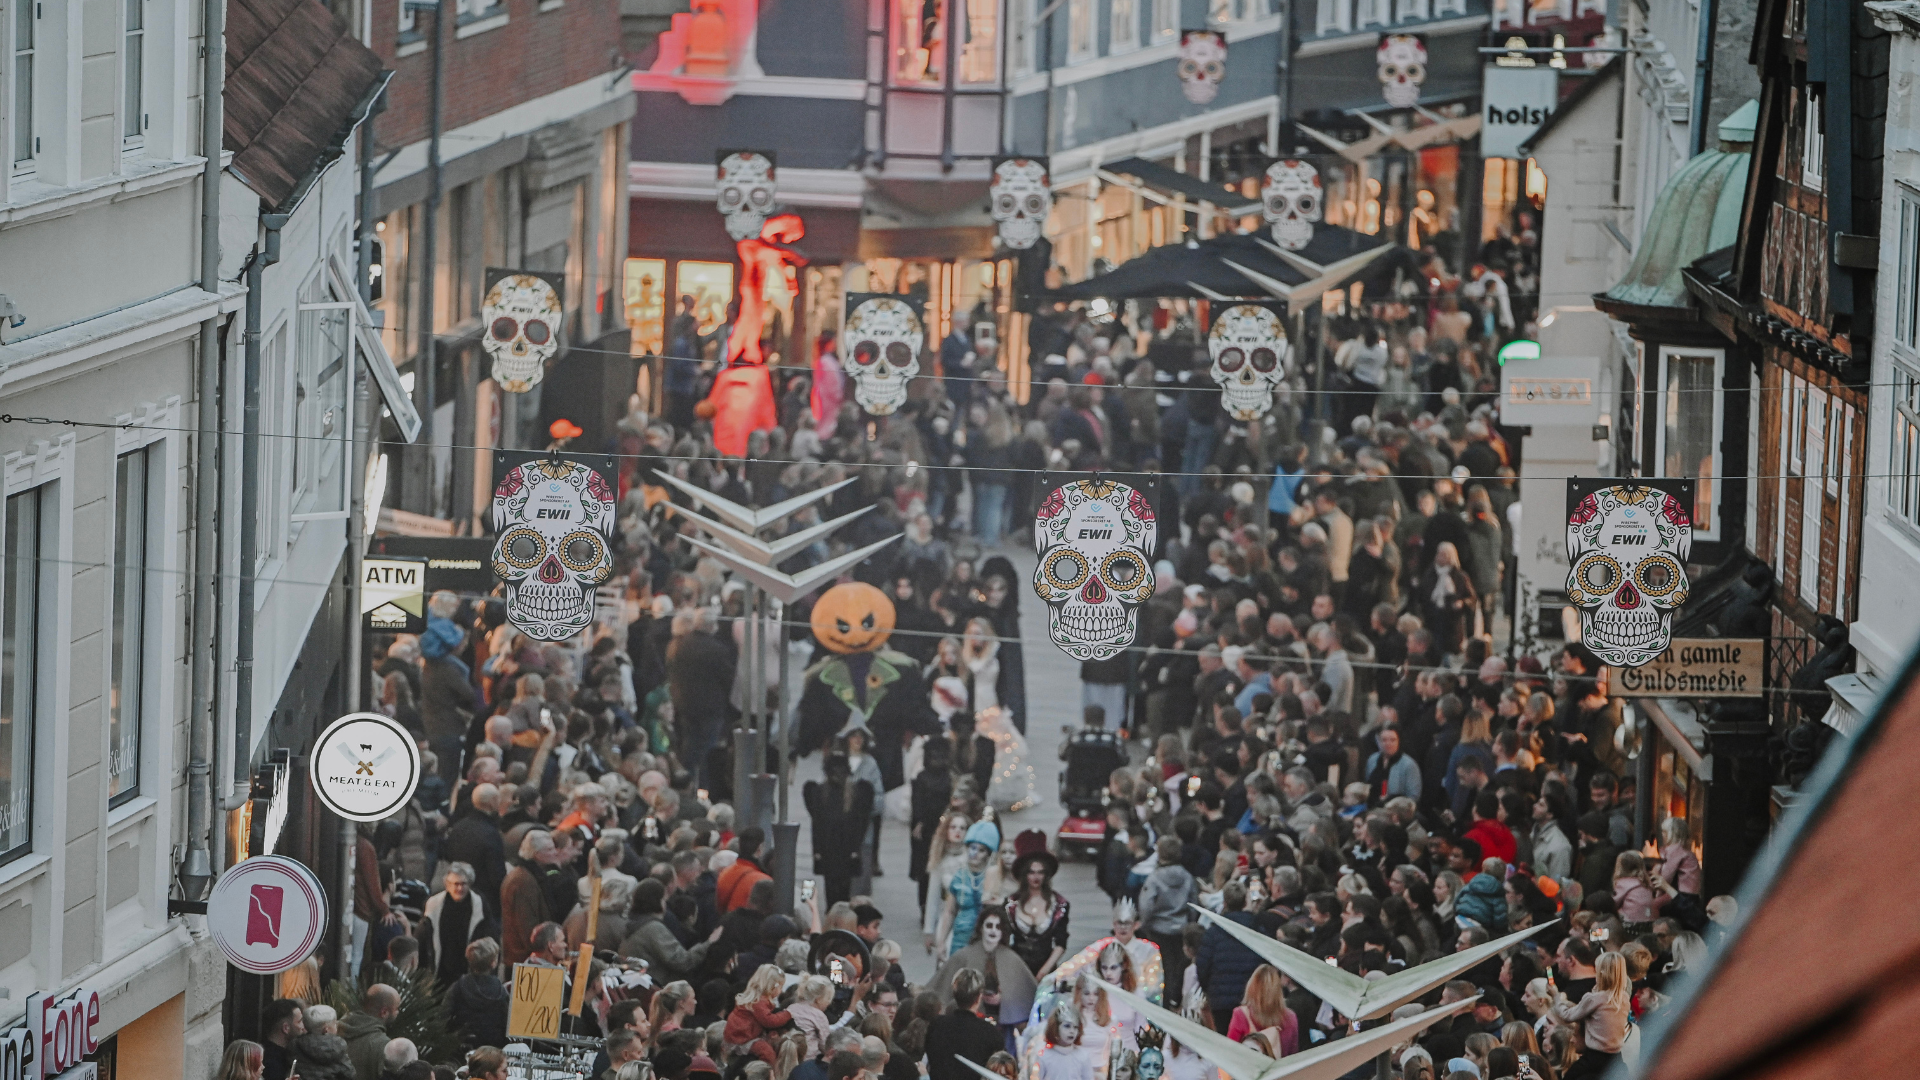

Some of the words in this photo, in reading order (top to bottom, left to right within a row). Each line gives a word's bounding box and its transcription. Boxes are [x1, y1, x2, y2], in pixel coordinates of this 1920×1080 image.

[366, 567, 416, 585] ATM
[1680, 643, 1741, 667] gamle
[1620, 667, 1747, 692] Guldsmedie
[329, 776, 361, 786] MEAT
[364, 778, 371, 787] &
[375, 779, 396, 788] EAT
[41, 991, 100, 1080] Fone
